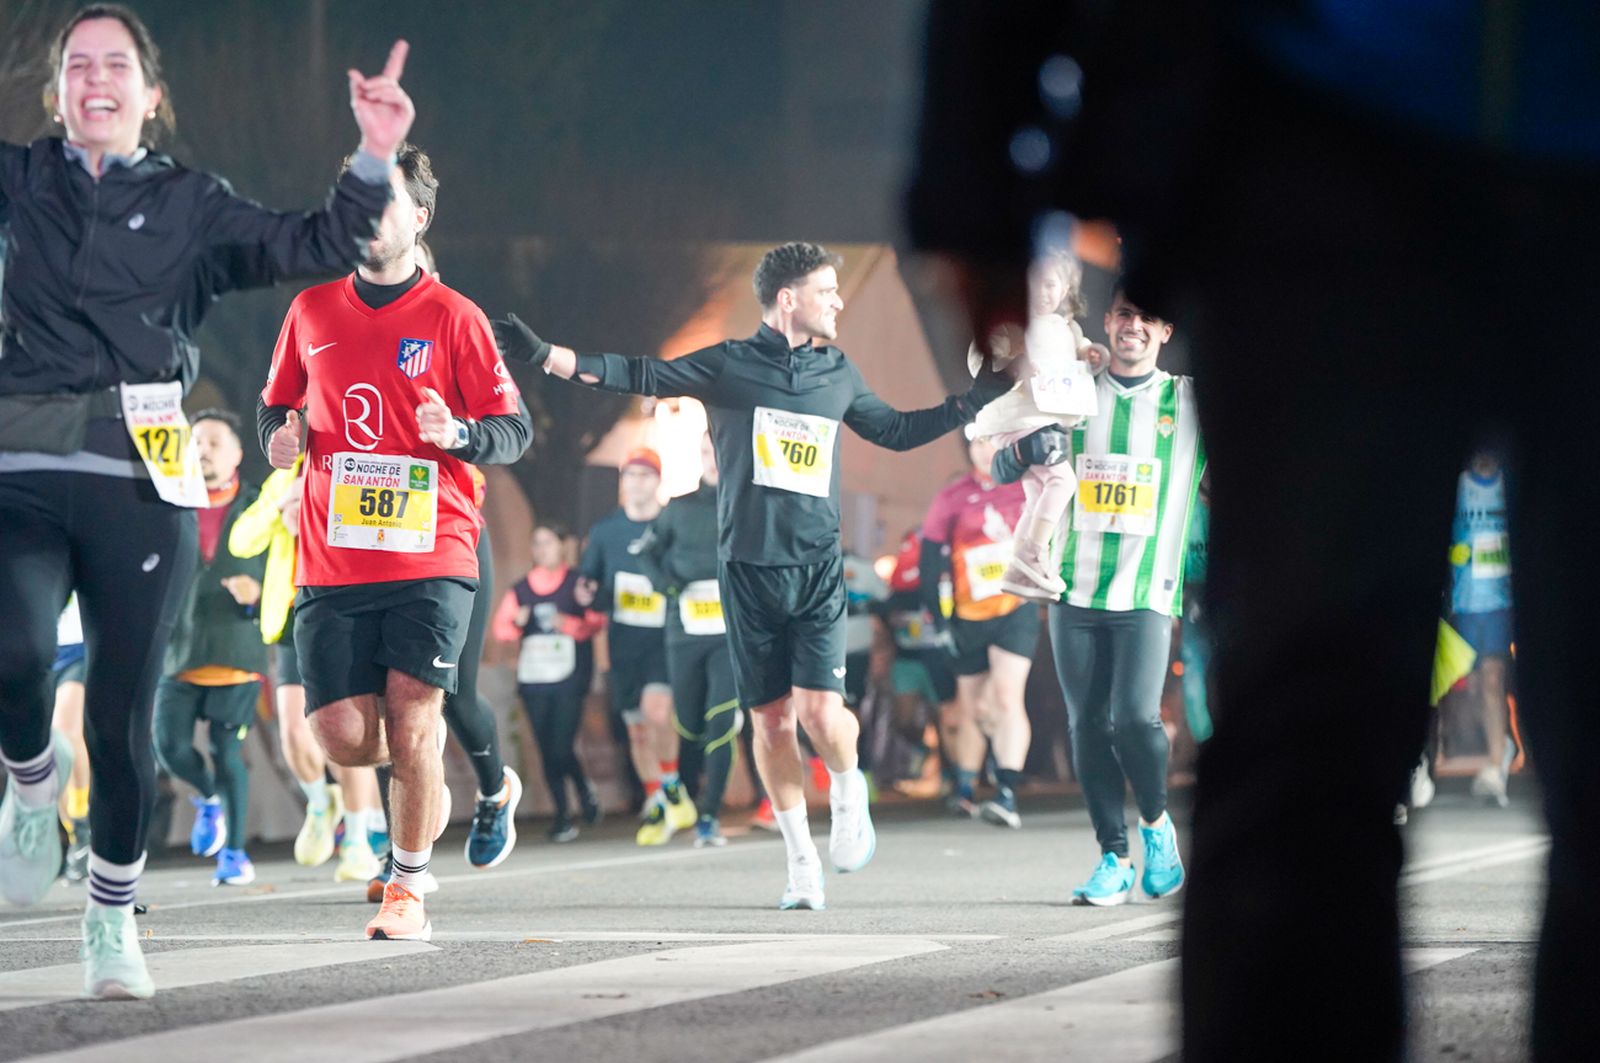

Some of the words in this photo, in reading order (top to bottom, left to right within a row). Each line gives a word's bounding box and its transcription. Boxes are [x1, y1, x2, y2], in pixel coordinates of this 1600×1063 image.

[780, 440, 817, 467] 760
[356, 464, 387, 475] NOCHE
[389, 465, 401, 476] DE
[343, 474, 364, 485] SAN
[1094, 482, 1137, 506] 1761
[360, 488, 409, 519] 587
[361, 518, 377, 526] Juan
